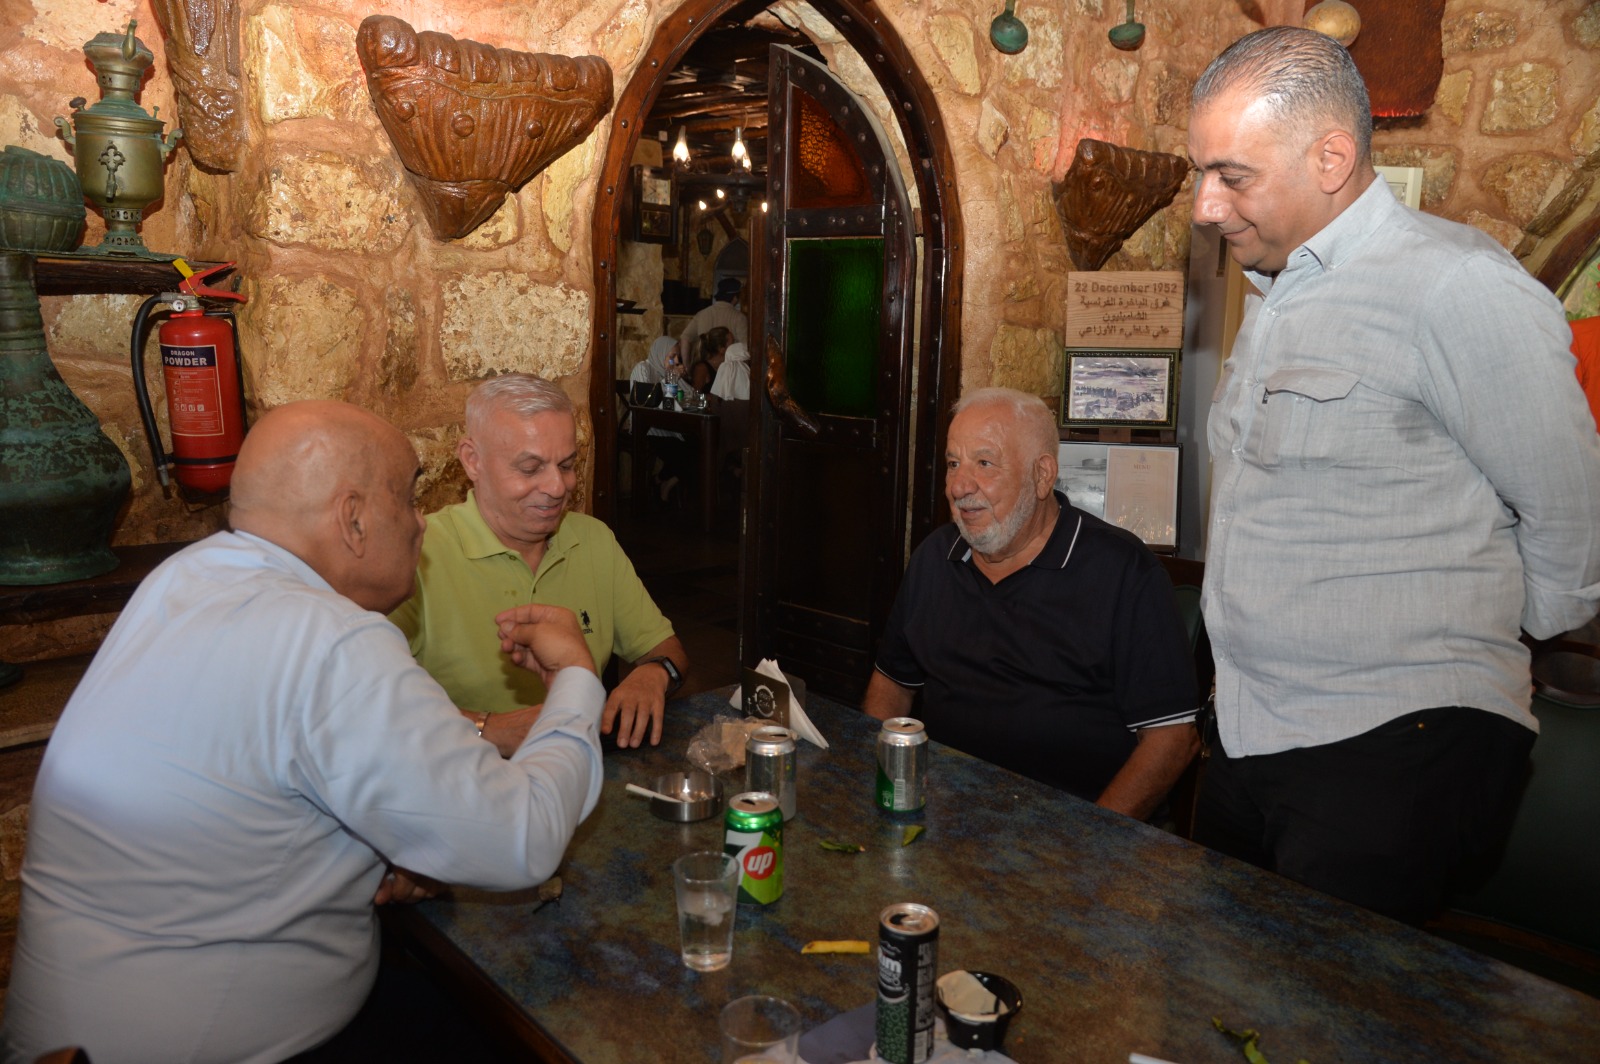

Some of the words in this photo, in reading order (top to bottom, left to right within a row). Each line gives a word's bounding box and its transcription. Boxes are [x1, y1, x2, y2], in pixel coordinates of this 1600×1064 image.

[1075, 282, 1088, 293] 22
[1091, 282, 1150, 293] December
[1153, 283, 1177, 293] 1952
[1080, 296, 1116, 308] الفرنسية
[1119, 297, 1147, 308] الباخرة
[1150, 297, 1170, 309] غرق
[164, 356, 207, 366] POWDER
